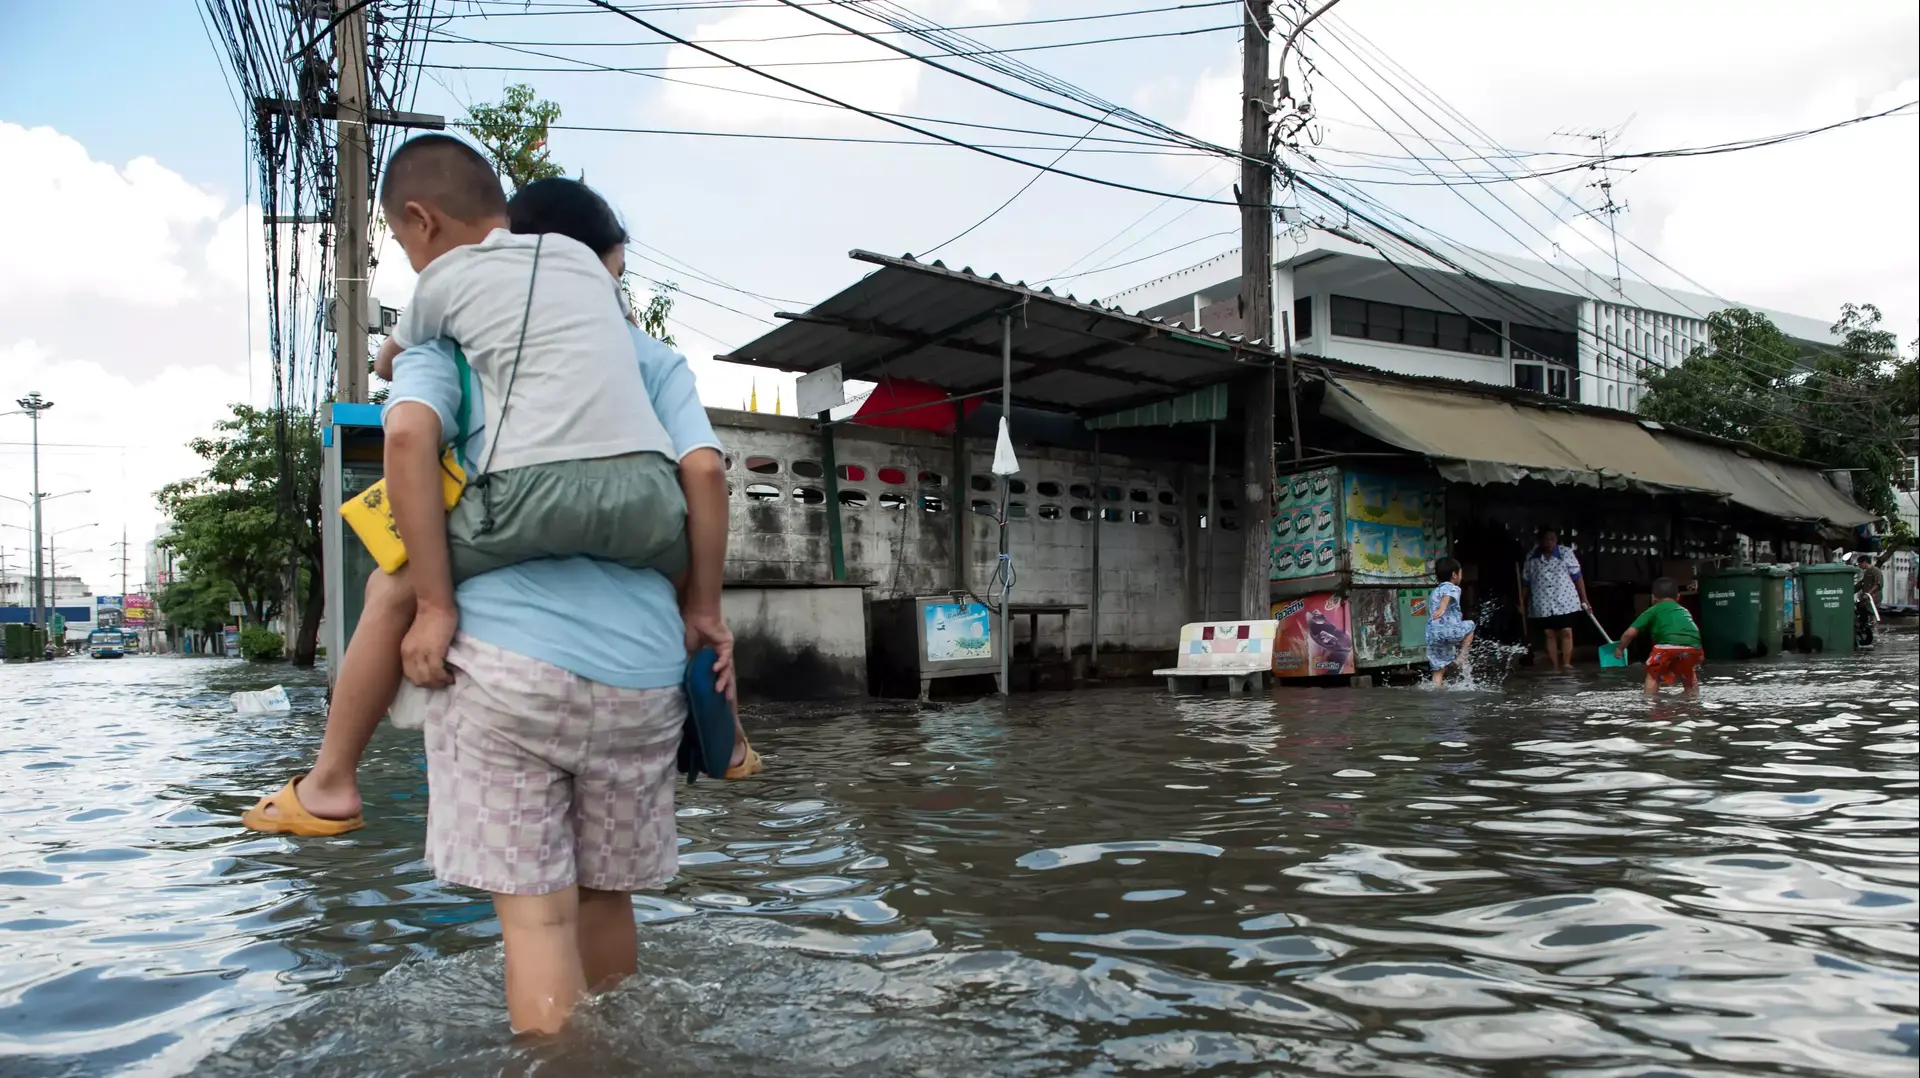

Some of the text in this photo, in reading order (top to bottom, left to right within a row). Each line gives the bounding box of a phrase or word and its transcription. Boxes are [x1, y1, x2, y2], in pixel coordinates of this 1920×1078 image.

[1294, 481, 1309, 495] Vim
[1277, 519, 1291, 533] Vim
[1296, 516, 1311, 530] Vim
[1319, 548, 1333, 562] Vim
